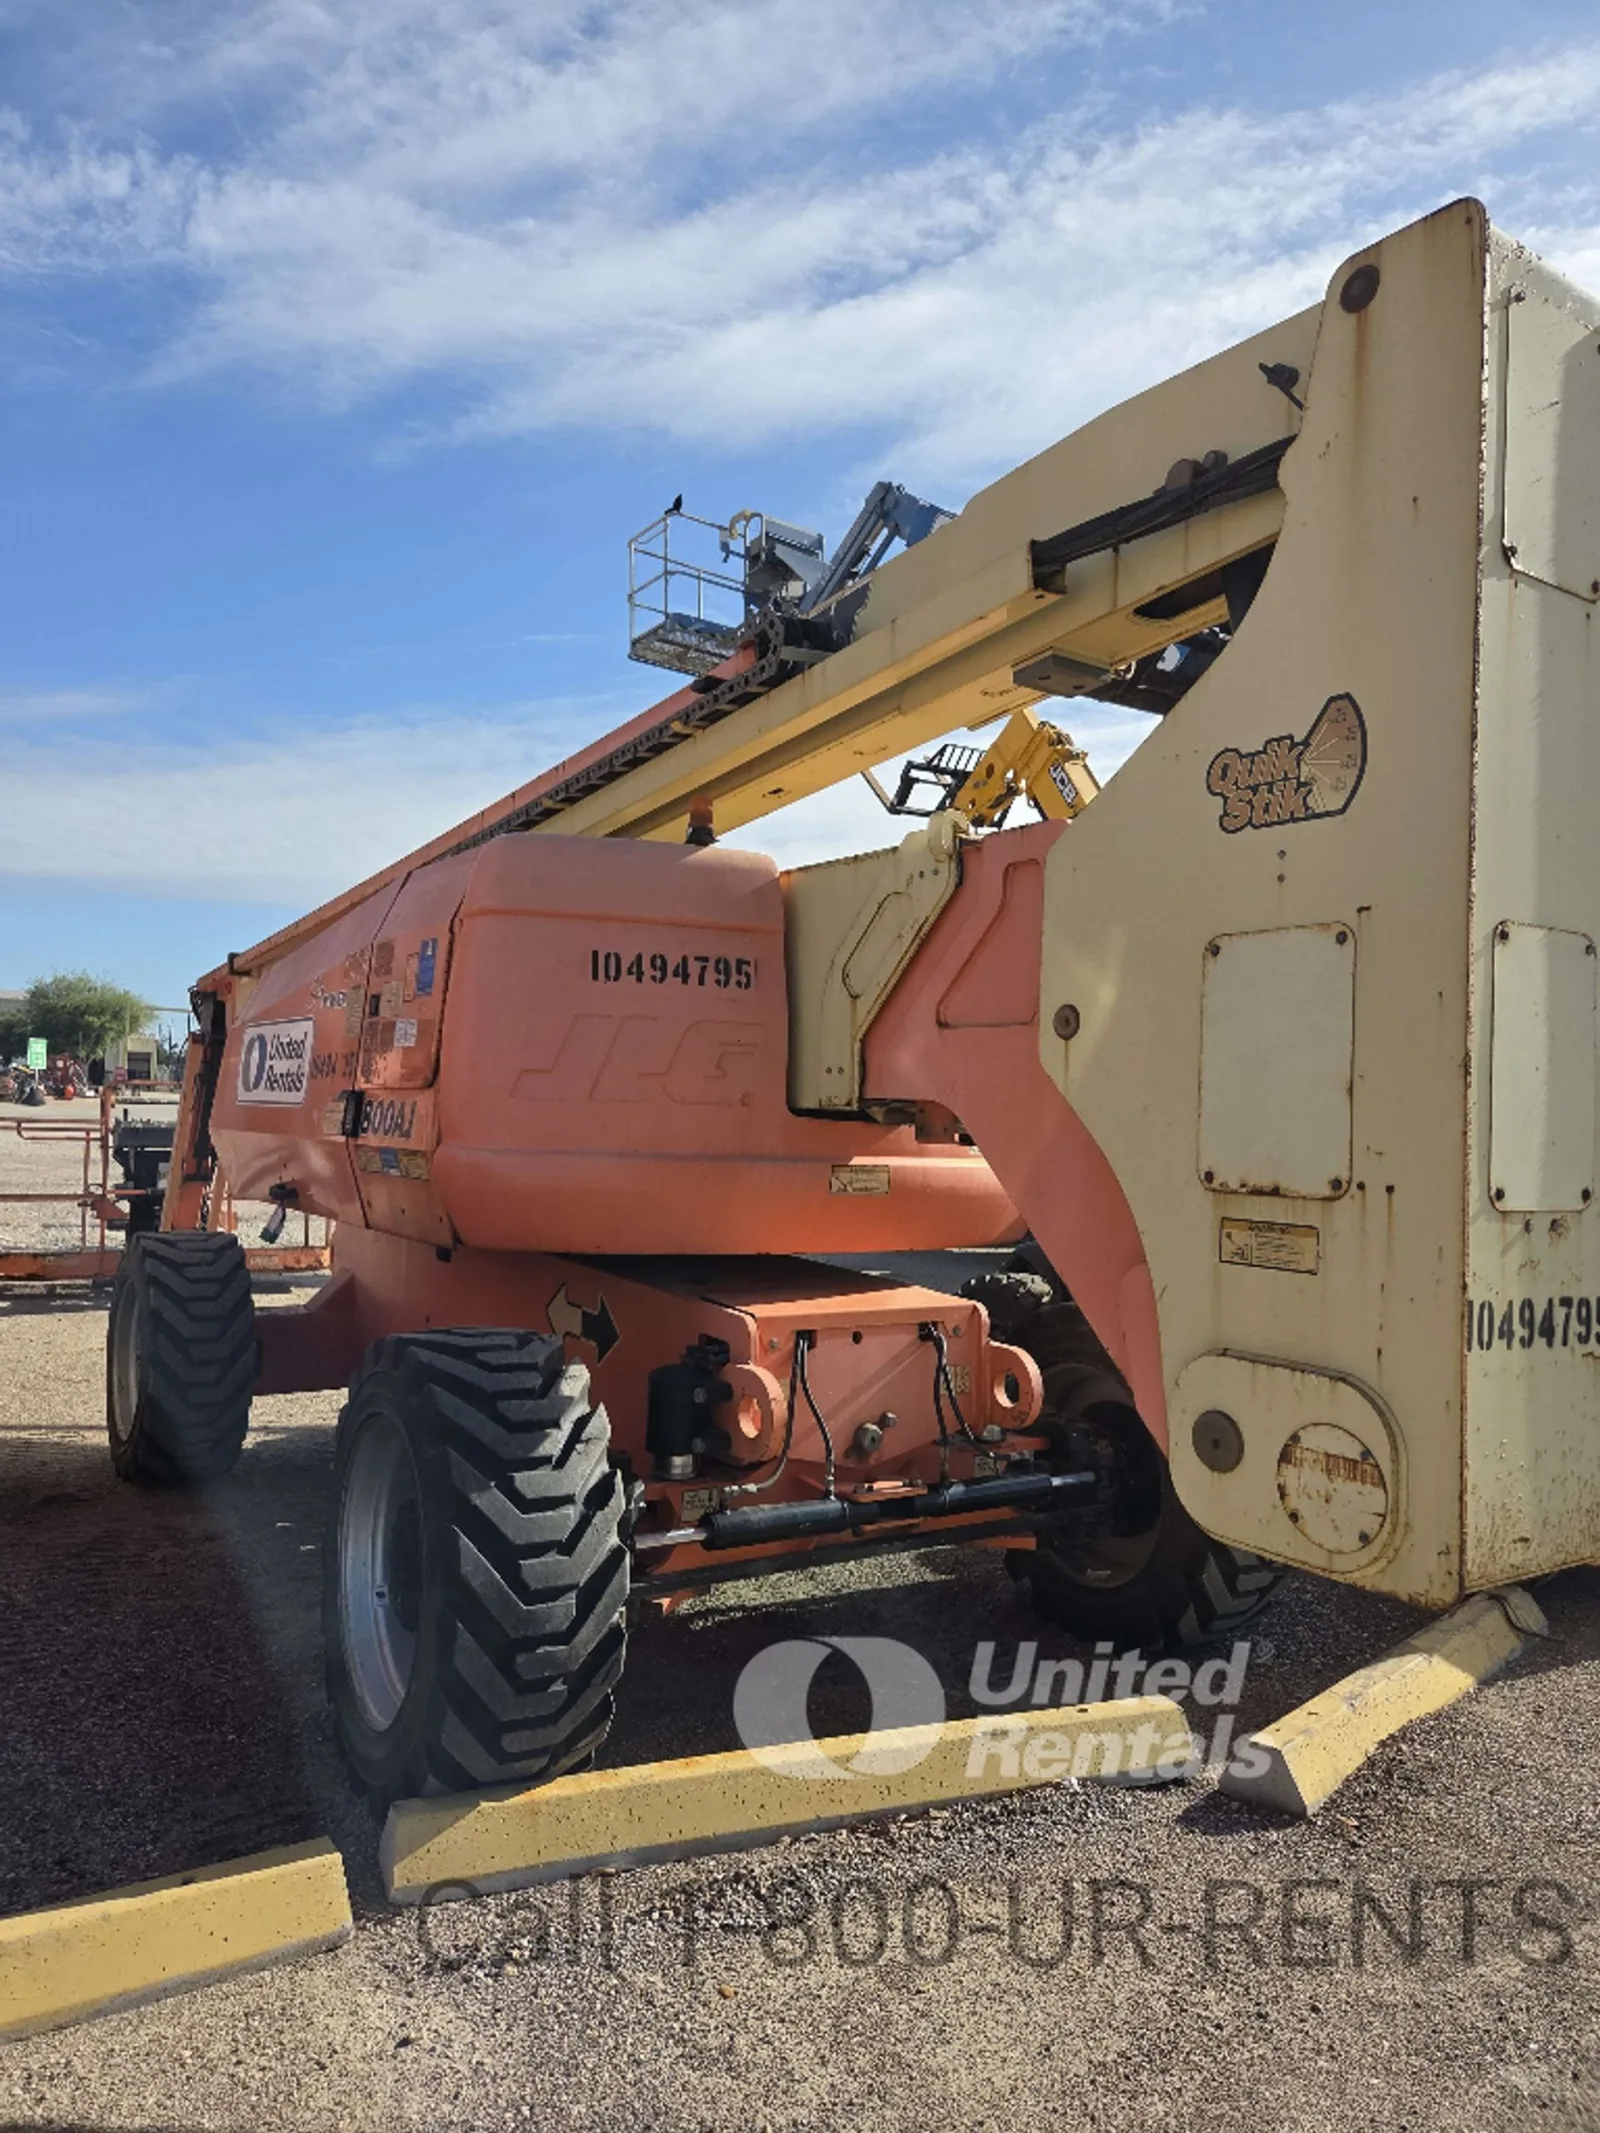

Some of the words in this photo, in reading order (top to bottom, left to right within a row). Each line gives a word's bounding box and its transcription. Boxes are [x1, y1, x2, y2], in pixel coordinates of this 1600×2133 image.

[1049, 761, 1077, 804] JCB
[591, 949, 753, 991] 10494795
[268, 1031, 308, 1061] United
[264, 1064, 304, 1093] Rentals
